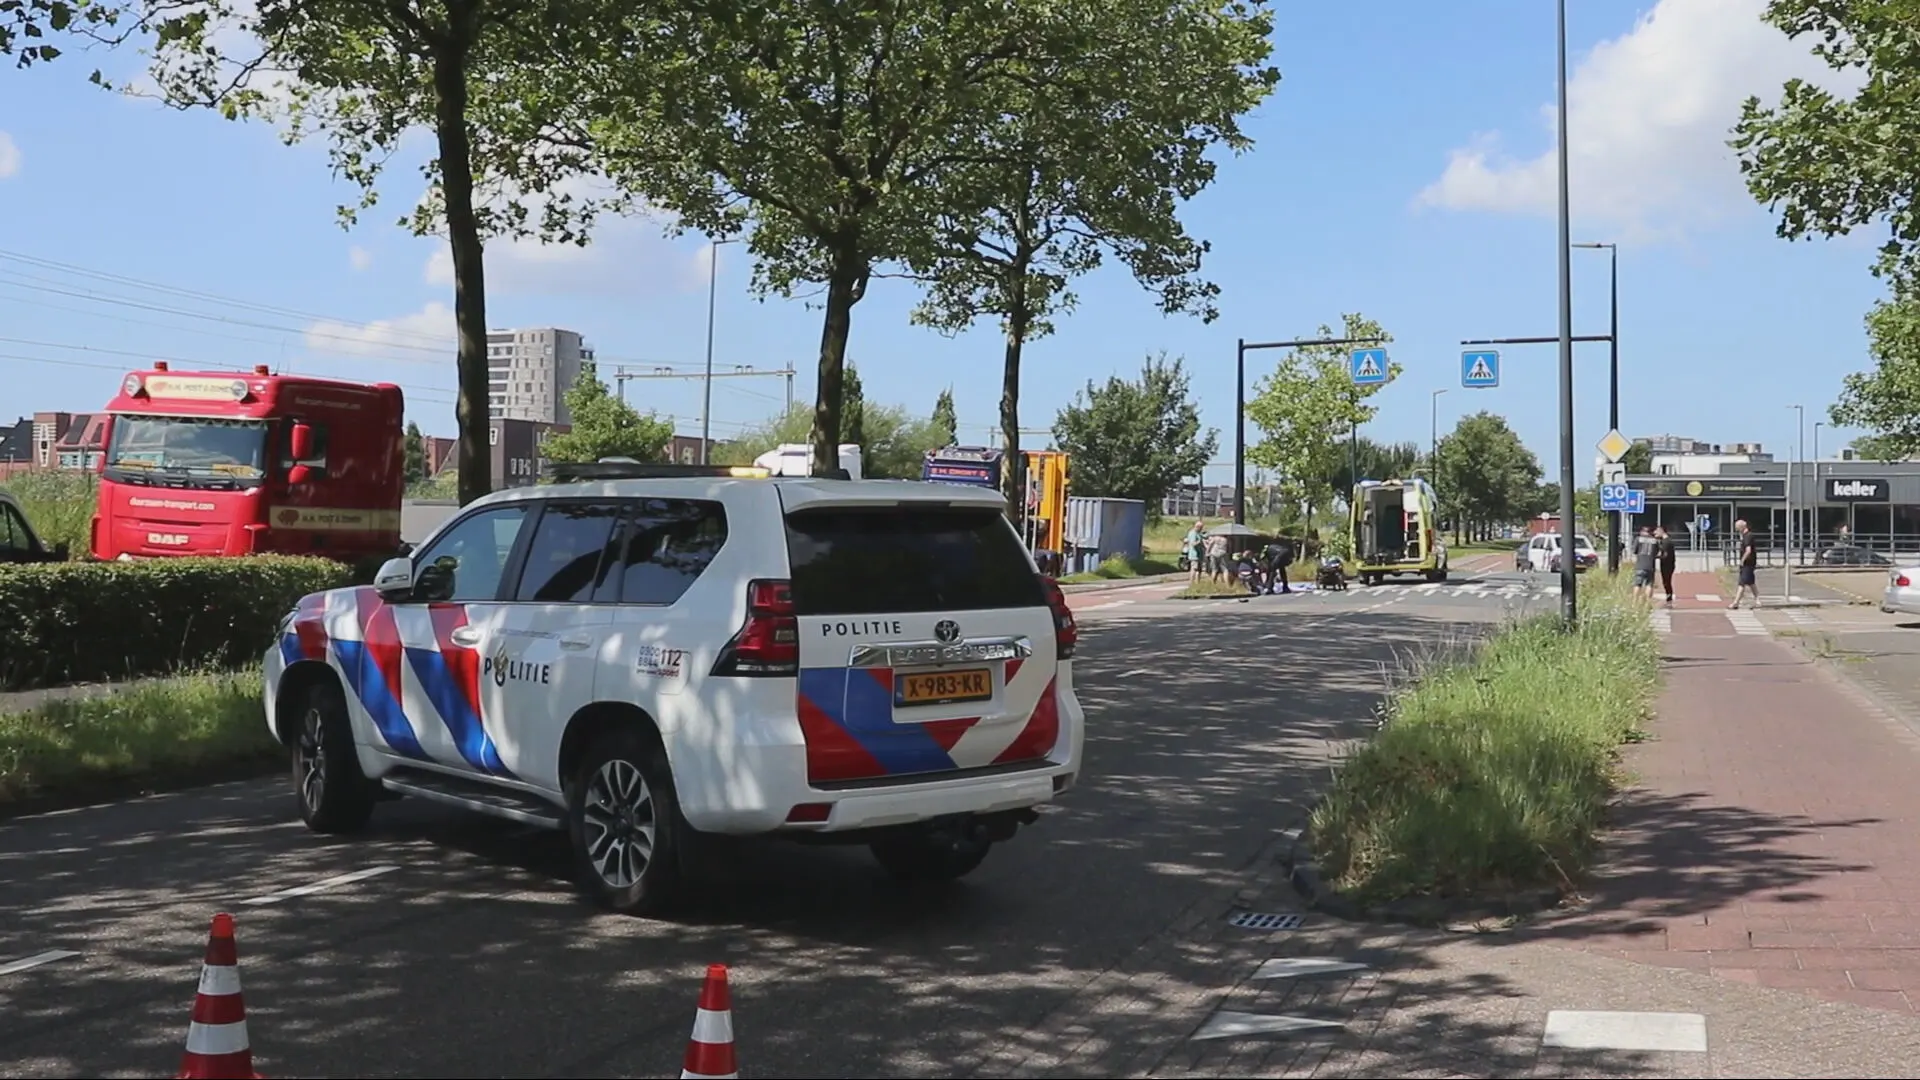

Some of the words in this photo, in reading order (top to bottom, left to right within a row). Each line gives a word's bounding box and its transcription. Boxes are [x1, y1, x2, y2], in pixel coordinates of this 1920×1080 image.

[1603, 486, 1626, 499] 30
[1833, 480, 1877, 496] keller
[147, 533, 189, 545] DAF
[822, 621, 902, 637] POLITIE
[661, 649, 682, 667] 112
[484, 657, 550, 687] POLITIE
[907, 674, 984, 697] X-983-KR
